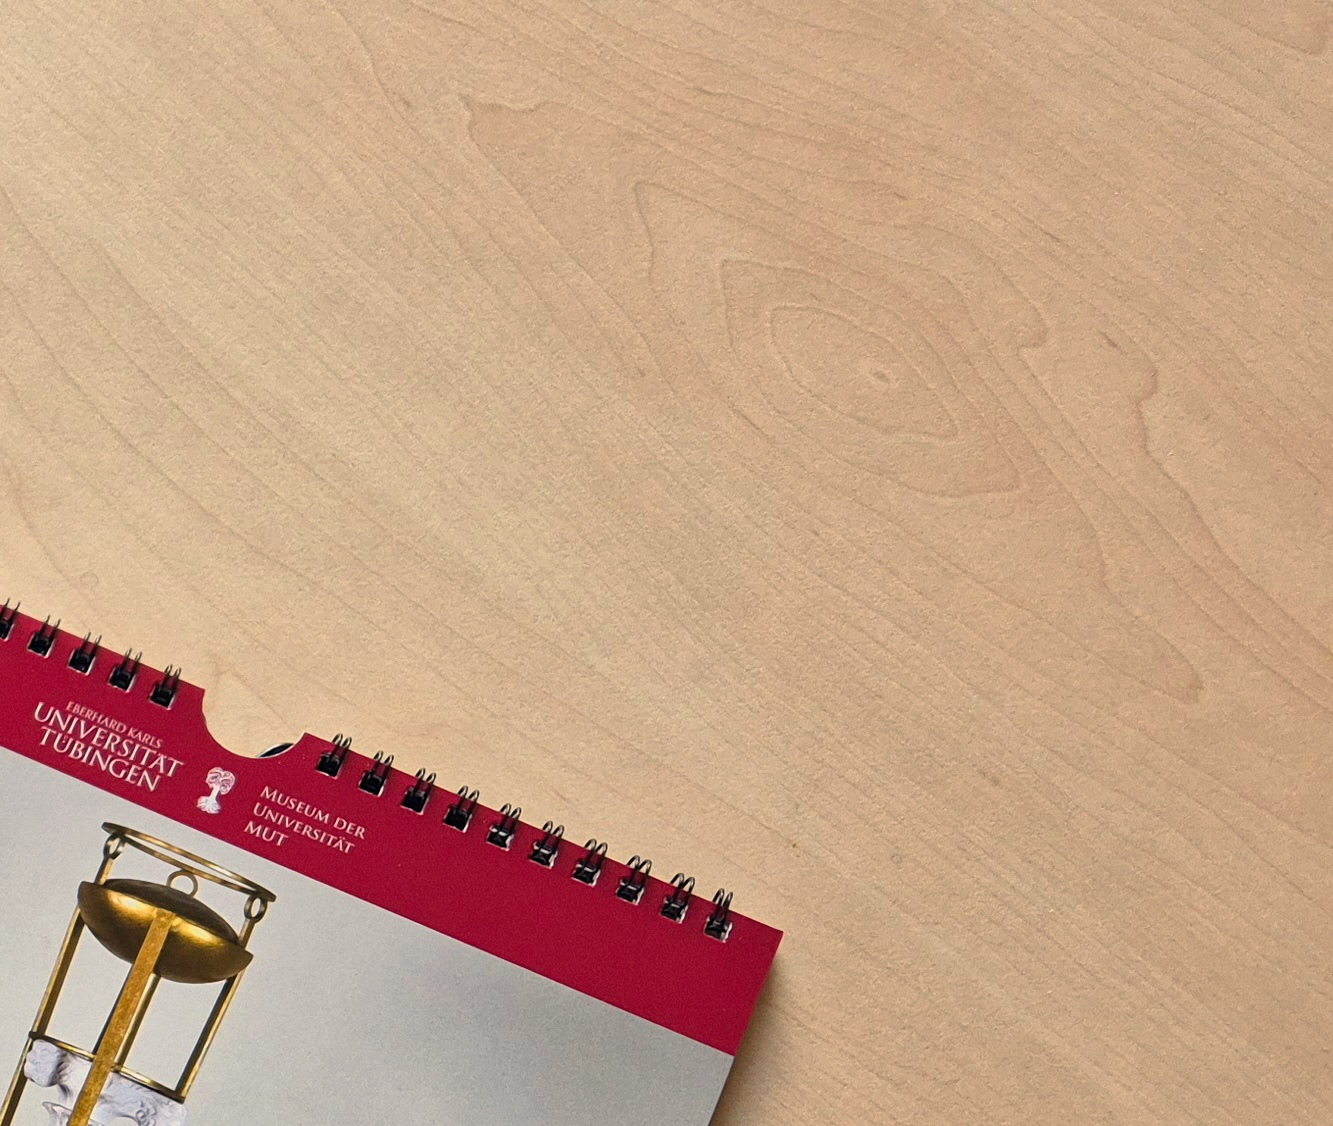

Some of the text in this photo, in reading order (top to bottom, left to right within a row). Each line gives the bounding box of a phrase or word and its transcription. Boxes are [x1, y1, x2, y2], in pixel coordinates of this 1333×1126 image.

[34, 702, 183, 778] UNIVERSITÄT
[66, 701, 163, 749] EBERHARD KARLS
[39, 725, 162, 791] TÜBINGEN
[244, 821, 289, 847] MUT
[253, 802, 355, 854] UNIVERSITÄT
[259, 785, 367, 840] MUSEUM DER
